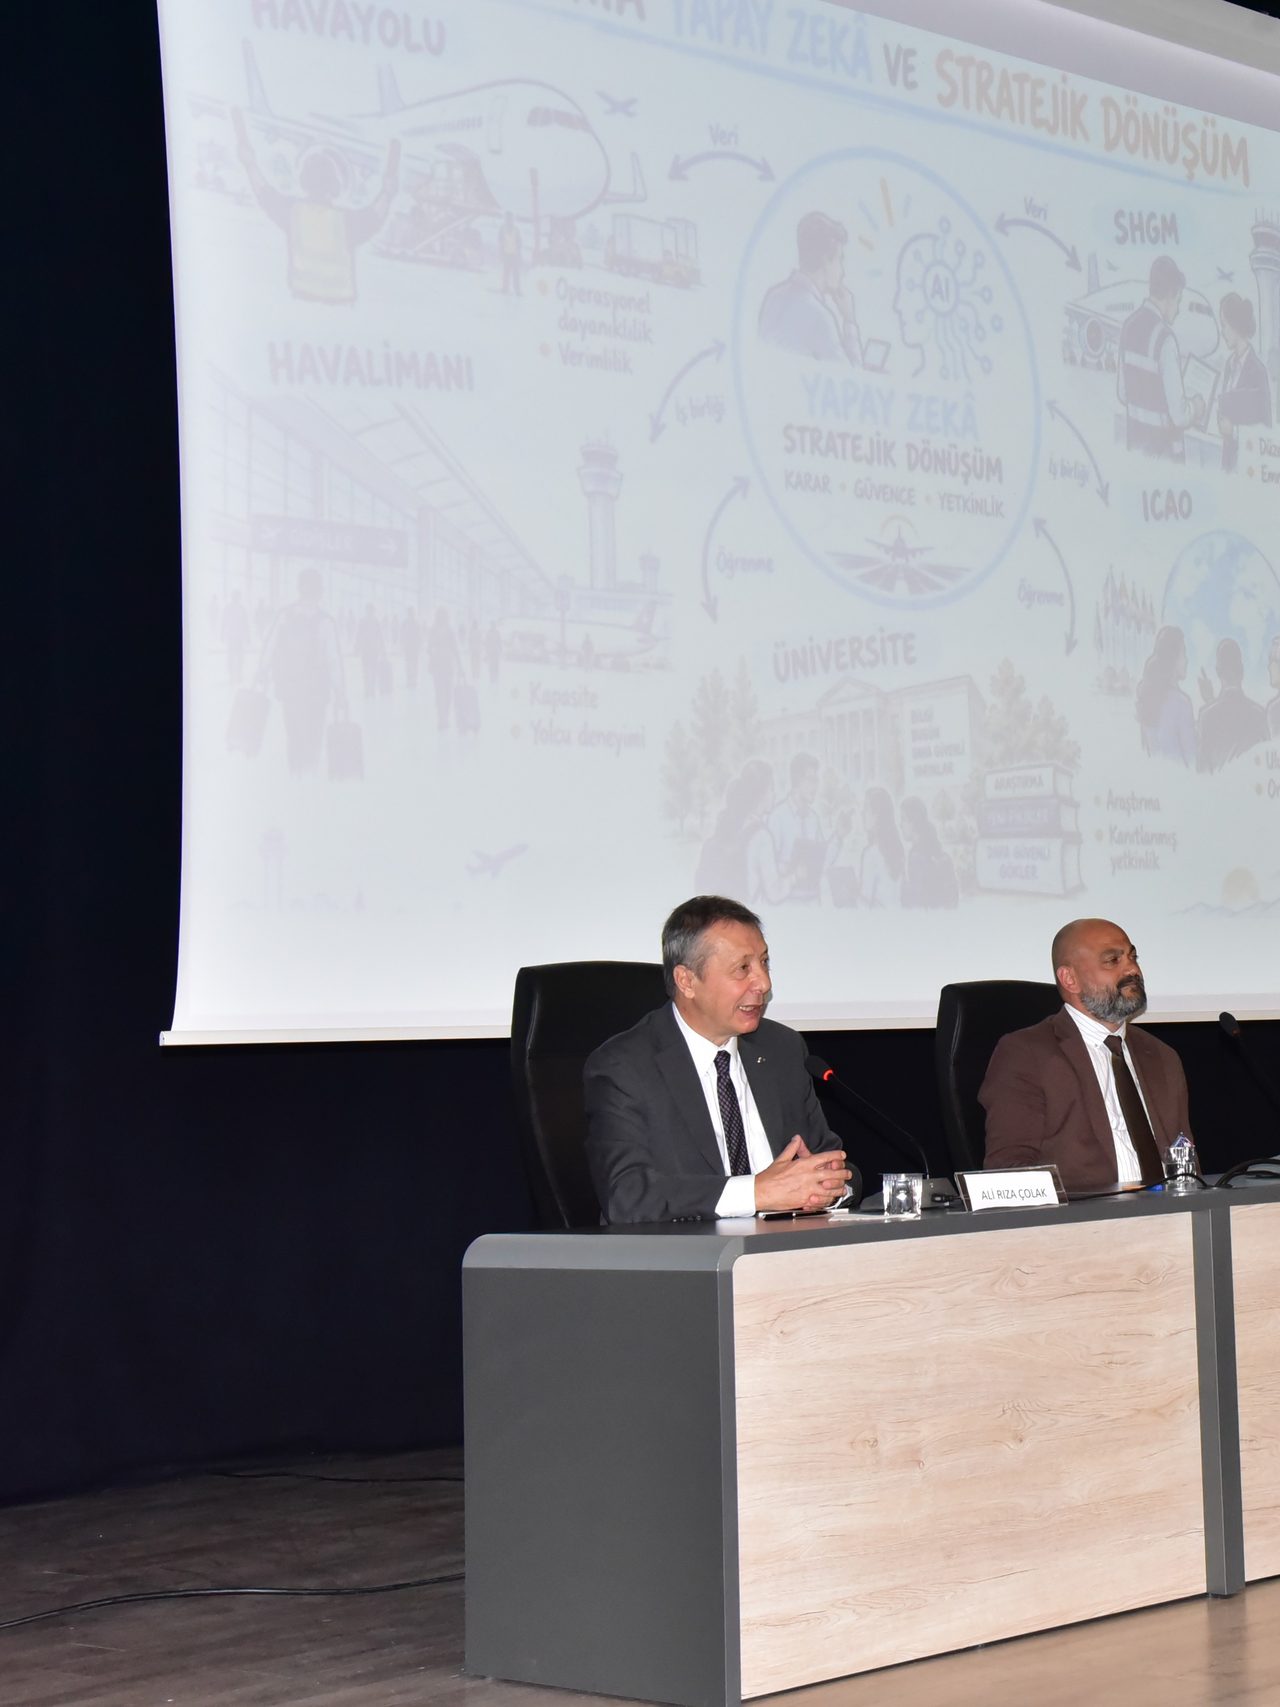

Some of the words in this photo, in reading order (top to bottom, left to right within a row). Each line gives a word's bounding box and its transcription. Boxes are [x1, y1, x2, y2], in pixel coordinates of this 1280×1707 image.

[252, 0, 446, 56] HAVAYOLU
[786, 9, 873, 83] ZEKÂ
[883, 43, 918, 90] VE
[934, 48, 1090, 143] STRATEJİK
[1101, 94, 1251, 189] DÖNÜŞÜM
[708, 122, 740, 147] Veri
[1024, 197, 1048, 220] Veri
[1114, 209, 1180, 245] SHGM
[931, 274, 952, 298] AI
[268, 339, 475, 391] HAVALİMANI
[802, 371, 895, 427] YAPAY
[906, 386, 979, 441] ZEKÂ
[782, 423, 897, 468] STRATEJİK
[906, 440, 1003, 486] DÖNÜŞÜM
[784, 469, 831, 494] KARAR
[854, 479, 916, 507] GÜVENCE
[938, 491, 1006, 519] YETKİNLİK
[1142, 489, 1193, 522] ICAO
[772, 627, 918, 684] ÜNİVERSİTE
[981, 1188, 995, 1200] ALİ
[997, 1189, 1017, 1200] RIZA
[1018, 1188, 1048, 1201] ÇOLAK
